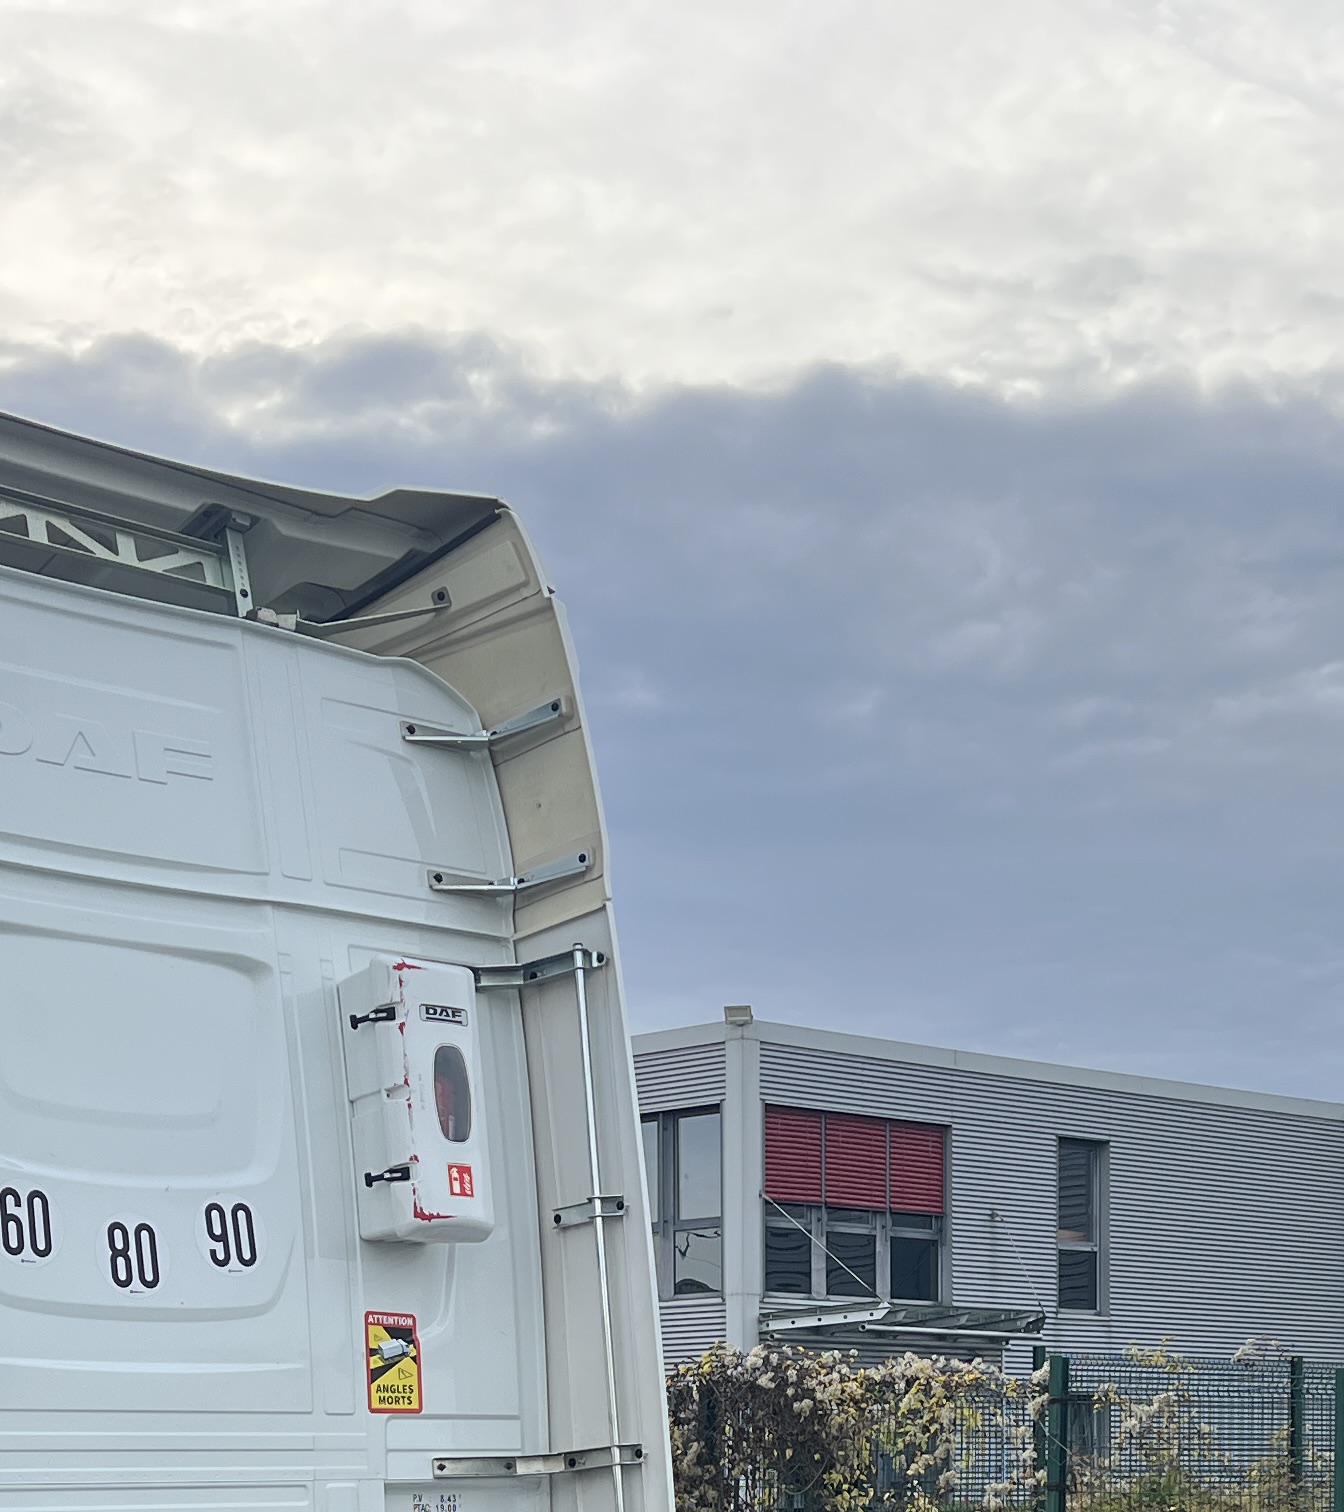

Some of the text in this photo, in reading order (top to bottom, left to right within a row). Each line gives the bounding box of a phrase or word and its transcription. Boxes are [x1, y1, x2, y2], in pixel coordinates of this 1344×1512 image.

[425, 1006, 462, 1019] DAF
[204, 1202, 257, 1268] 90
[107, 1221, 160, 1289] 80
[368, 1314, 414, 1327] ATTENTION
[375, 1383, 414, 1395] ANGLES
[378, 1395, 413, 1406] MORTS
